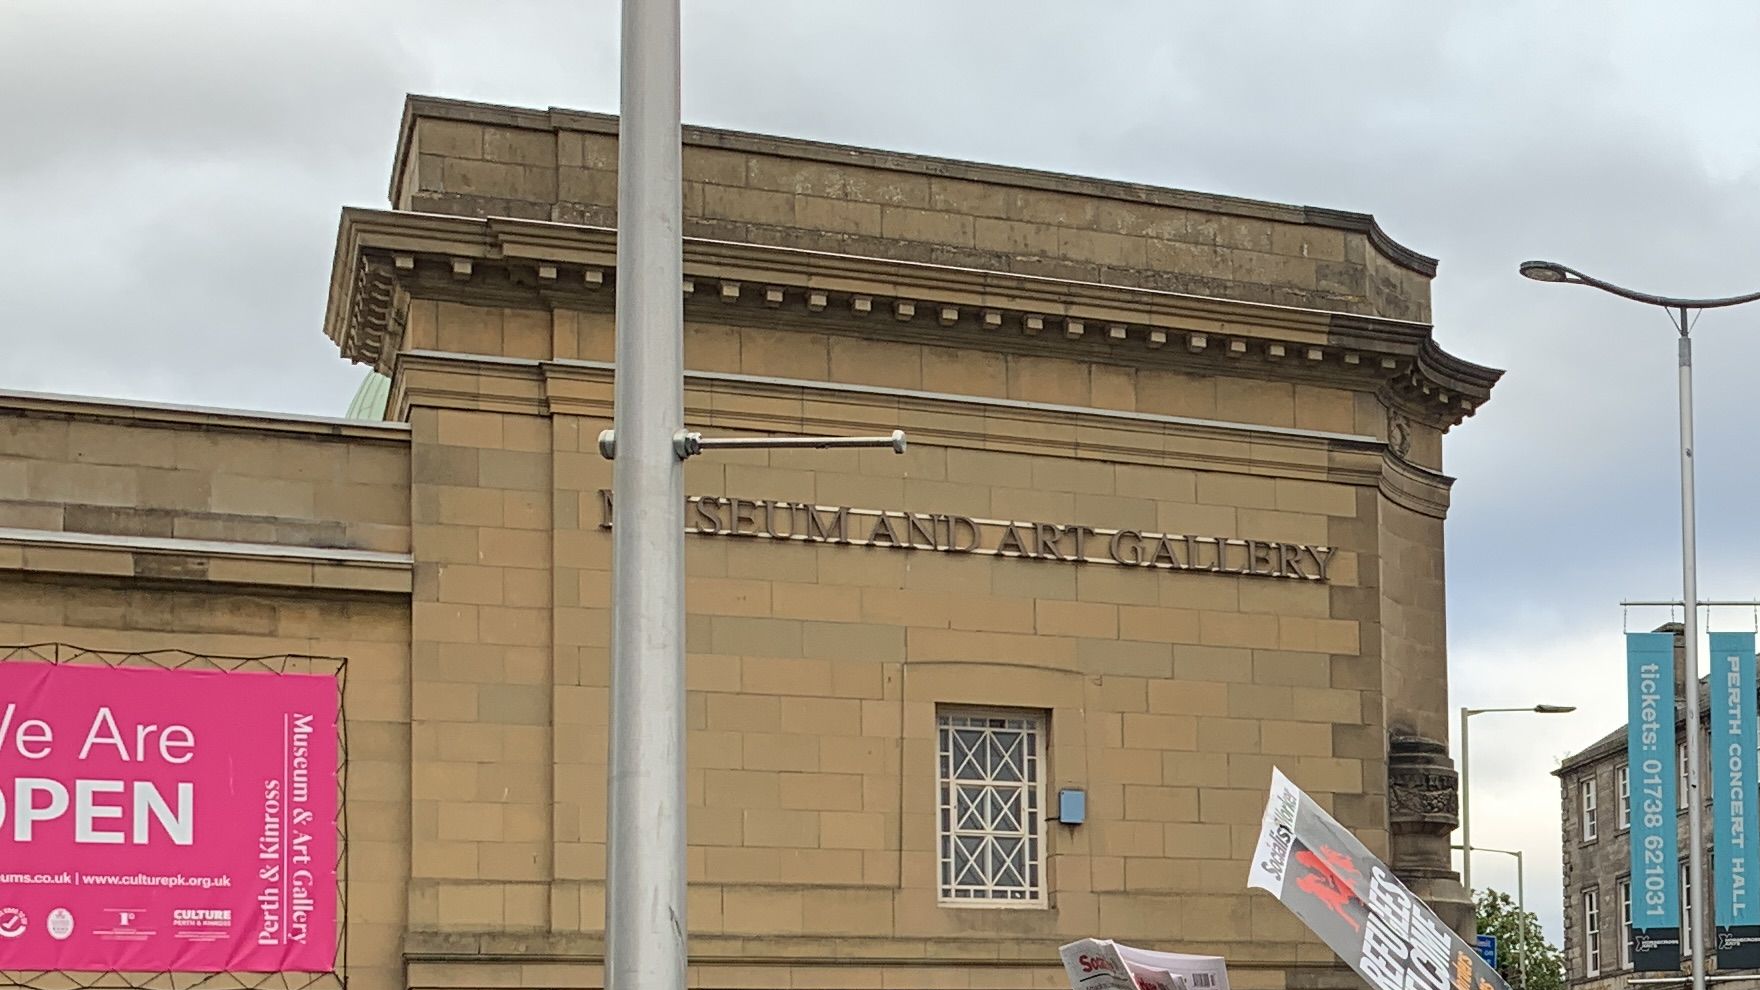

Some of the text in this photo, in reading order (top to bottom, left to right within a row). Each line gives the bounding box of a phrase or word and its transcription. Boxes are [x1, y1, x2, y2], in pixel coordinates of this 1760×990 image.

[868, 509, 982, 553] AND
[996, 519, 1097, 563] ART
[1109, 529, 1340, 582] GALLERY
[77, 706, 196, 765] Are
[1639, 662, 1666, 917] tickets: 01738 621031
[1726, 655, 1747, 917] PERTH CONCERT HALL
[0, 872, 231, 889] ums.co.uk www.culturepk.org.uk
[257, 778, 280, 945] Perth & Kinross
[288, 712, 314, 945] Museum & Art Gallery
[173, 909, 232, 921] CULTURE
